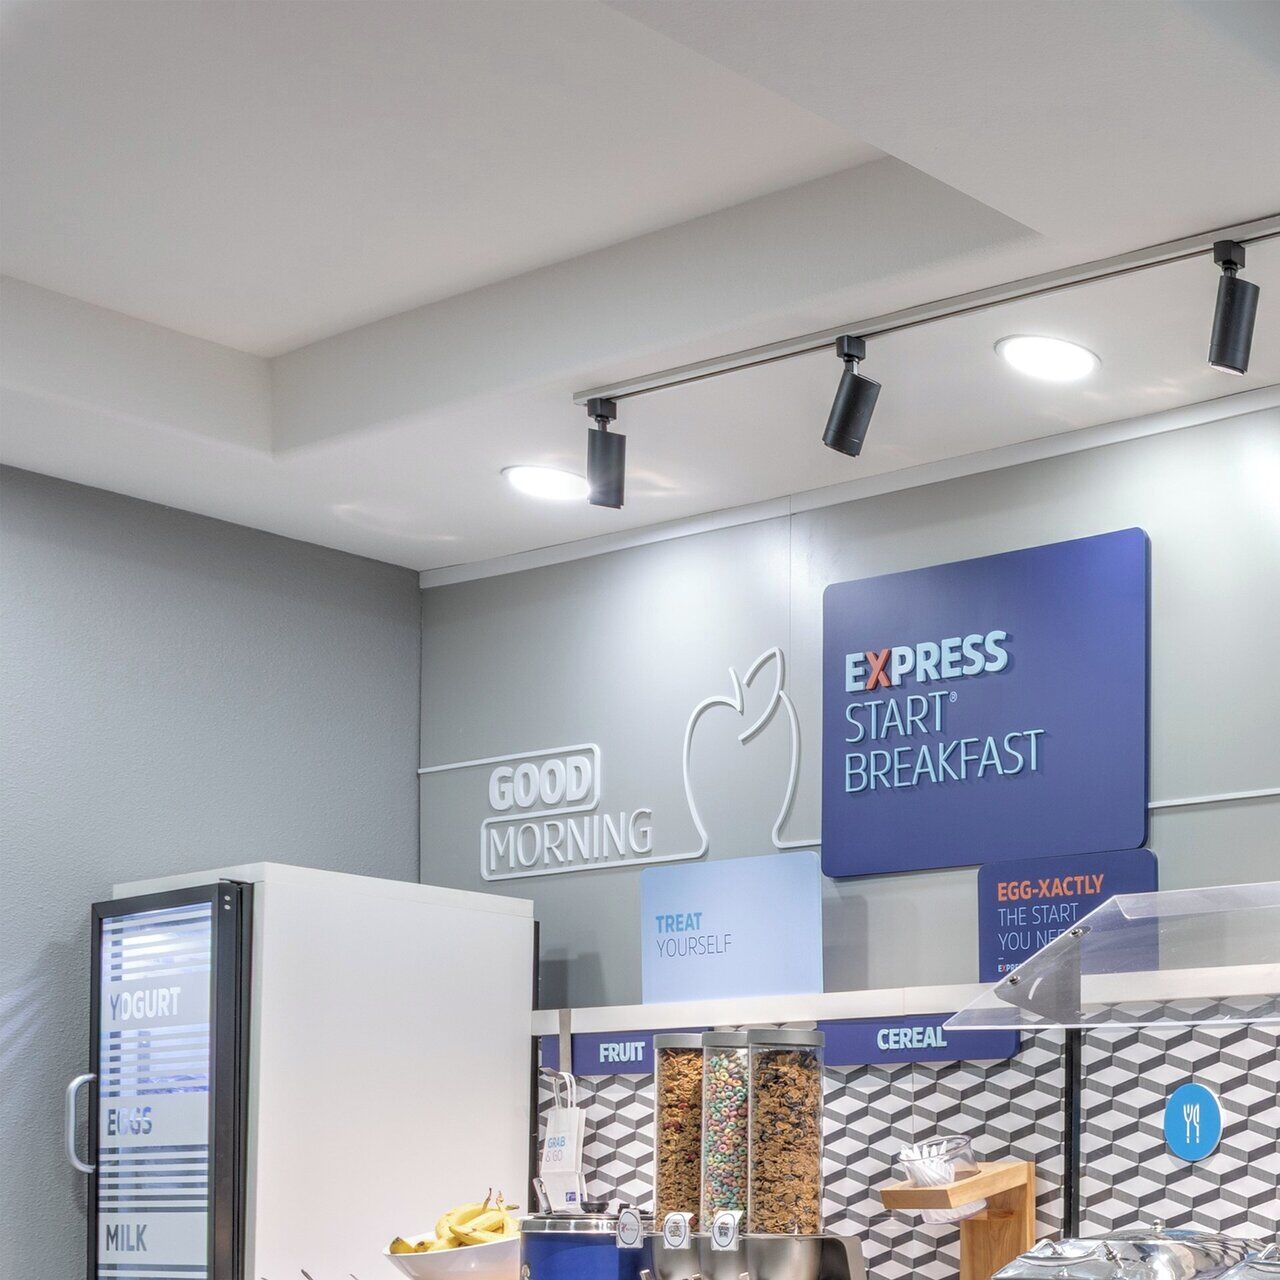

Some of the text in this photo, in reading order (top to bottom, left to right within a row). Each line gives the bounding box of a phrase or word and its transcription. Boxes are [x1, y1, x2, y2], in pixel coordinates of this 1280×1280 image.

[846, 630, 1008, 692] EXPRESS
[846, 729, 1044, 792] BREAKFAST
[489, 756, 592, 811] GOOD
[490, 808, 653, 871] MORNING
[997, 874, 1104, 902] EGG-XACTLY
[656, 912, 702, 934] TREAT
[998, 903, 1079, 927] THE START
[656, 934, 732, 959] YOURSELF
[998, 931, 1031, 951] YOU
[110, 987, 181, 1021] YOGURT
[877, 1026, 948, 1050] CEREAL
[599, 1041, 646, 1063] FRUIT
[107, 1107, 153, 1136] EGGS
[547, 1135, 566, 1149] GRAB
[553, 1150, 563, 1162] GO
[106, 1224, 148, 1252] MILK
